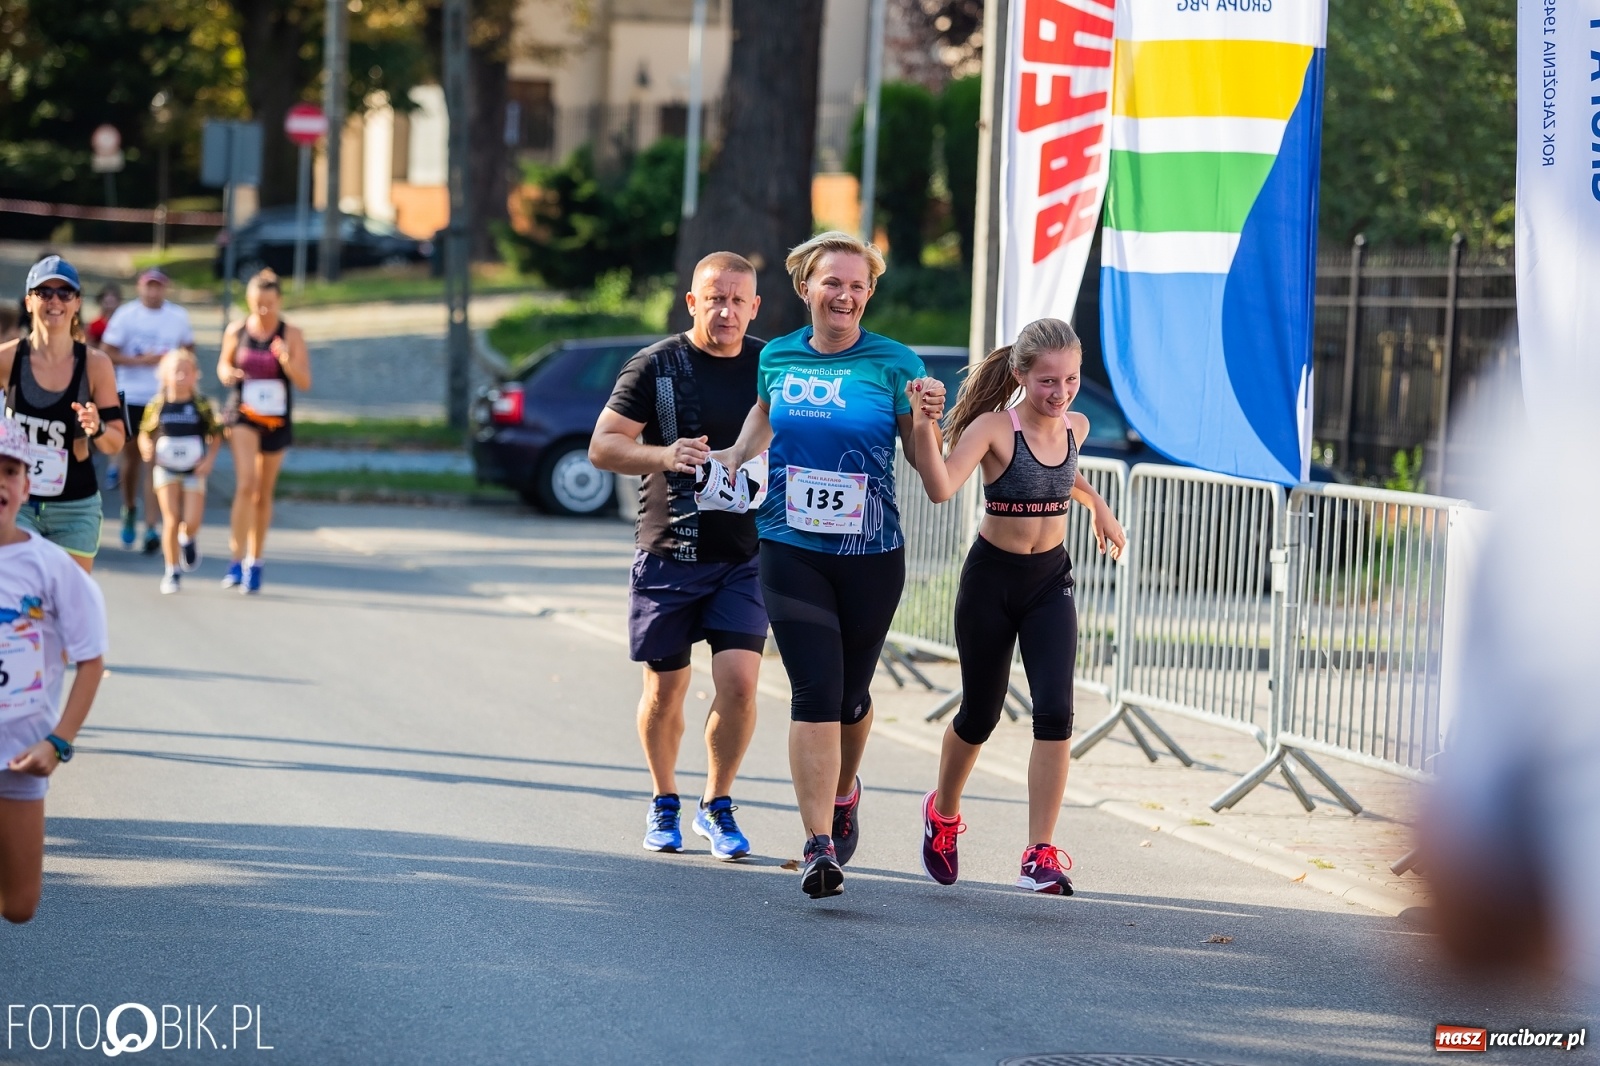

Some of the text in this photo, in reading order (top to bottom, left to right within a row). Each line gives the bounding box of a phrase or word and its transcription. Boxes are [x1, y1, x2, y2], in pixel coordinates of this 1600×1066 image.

[1017, 0, 1116, 265] RAFA
[782, 372, 847, 408] bbl
[789, 409, 832, 419] RACIBÓRZ
[806, 487, 844, 511] 135
[991, 501, 1010, 512] STAY
[1011, 503, 1024, 512] AS
[1026, 503, 1042, 512] YOU
[1044, 502, 1059, 512] ARE
